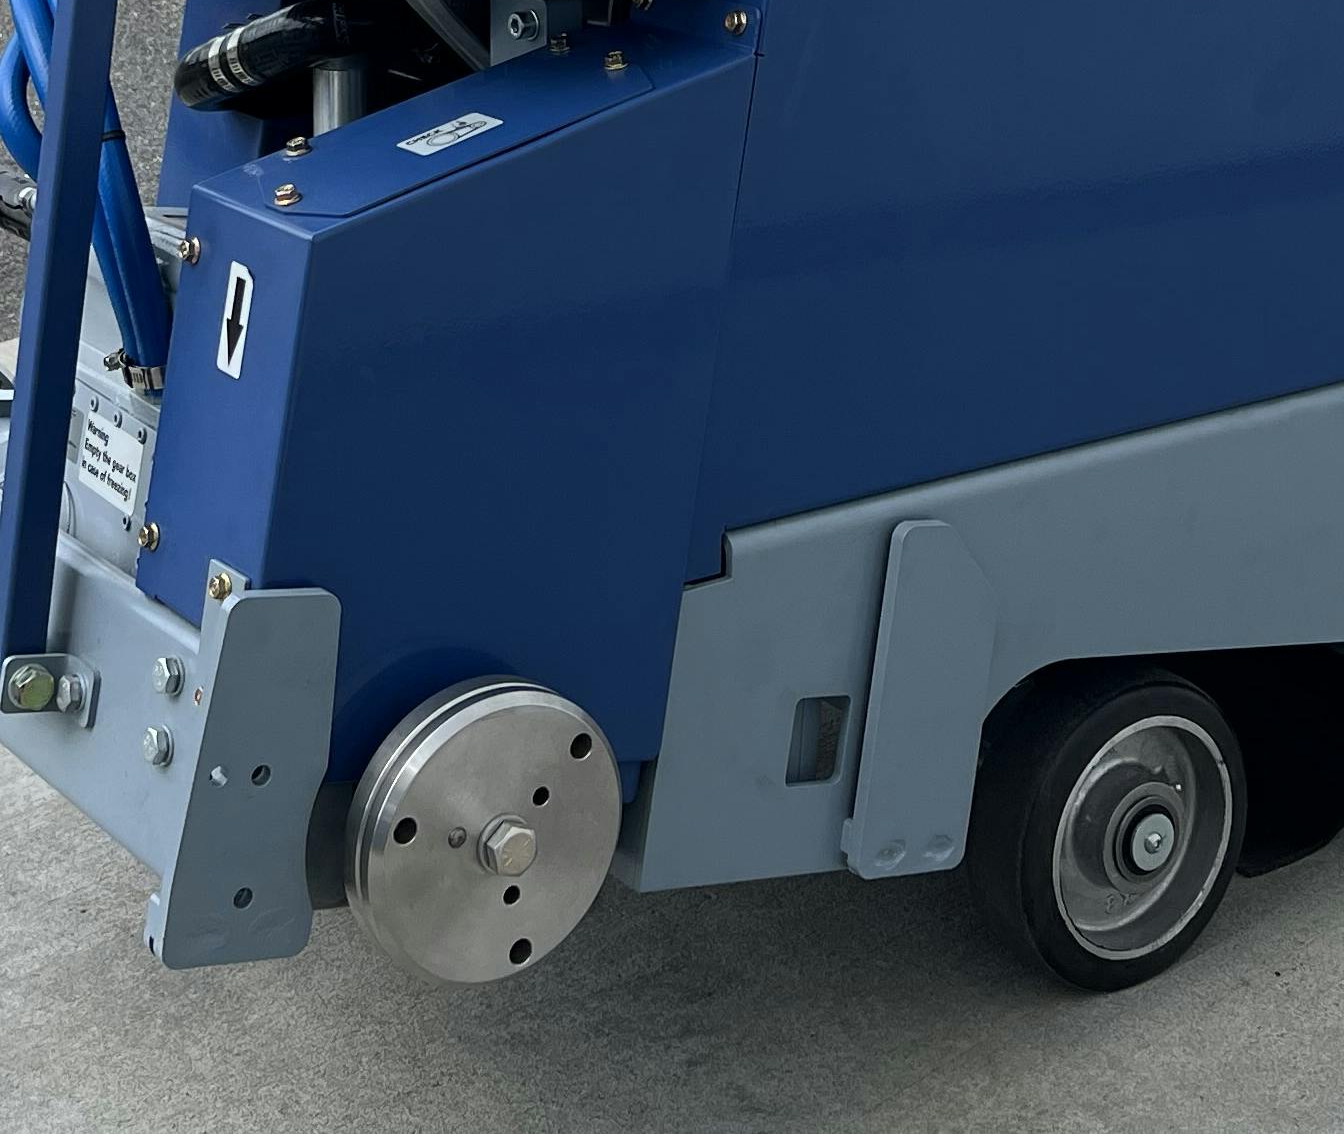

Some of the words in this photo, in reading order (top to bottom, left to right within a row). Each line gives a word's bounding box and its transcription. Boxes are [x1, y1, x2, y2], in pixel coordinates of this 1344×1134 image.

[88, 418, 109, 447] Warning
[84, 437, 101, 462] Empty
[103, 450, 111, 466] the
[112, 459, 125, 474] gear
[126, 463, 136, 482] box
[88, 463, 99, 478] case
[99, 470, 108, 482] of
[107, 472, 132, 502] freezing!
